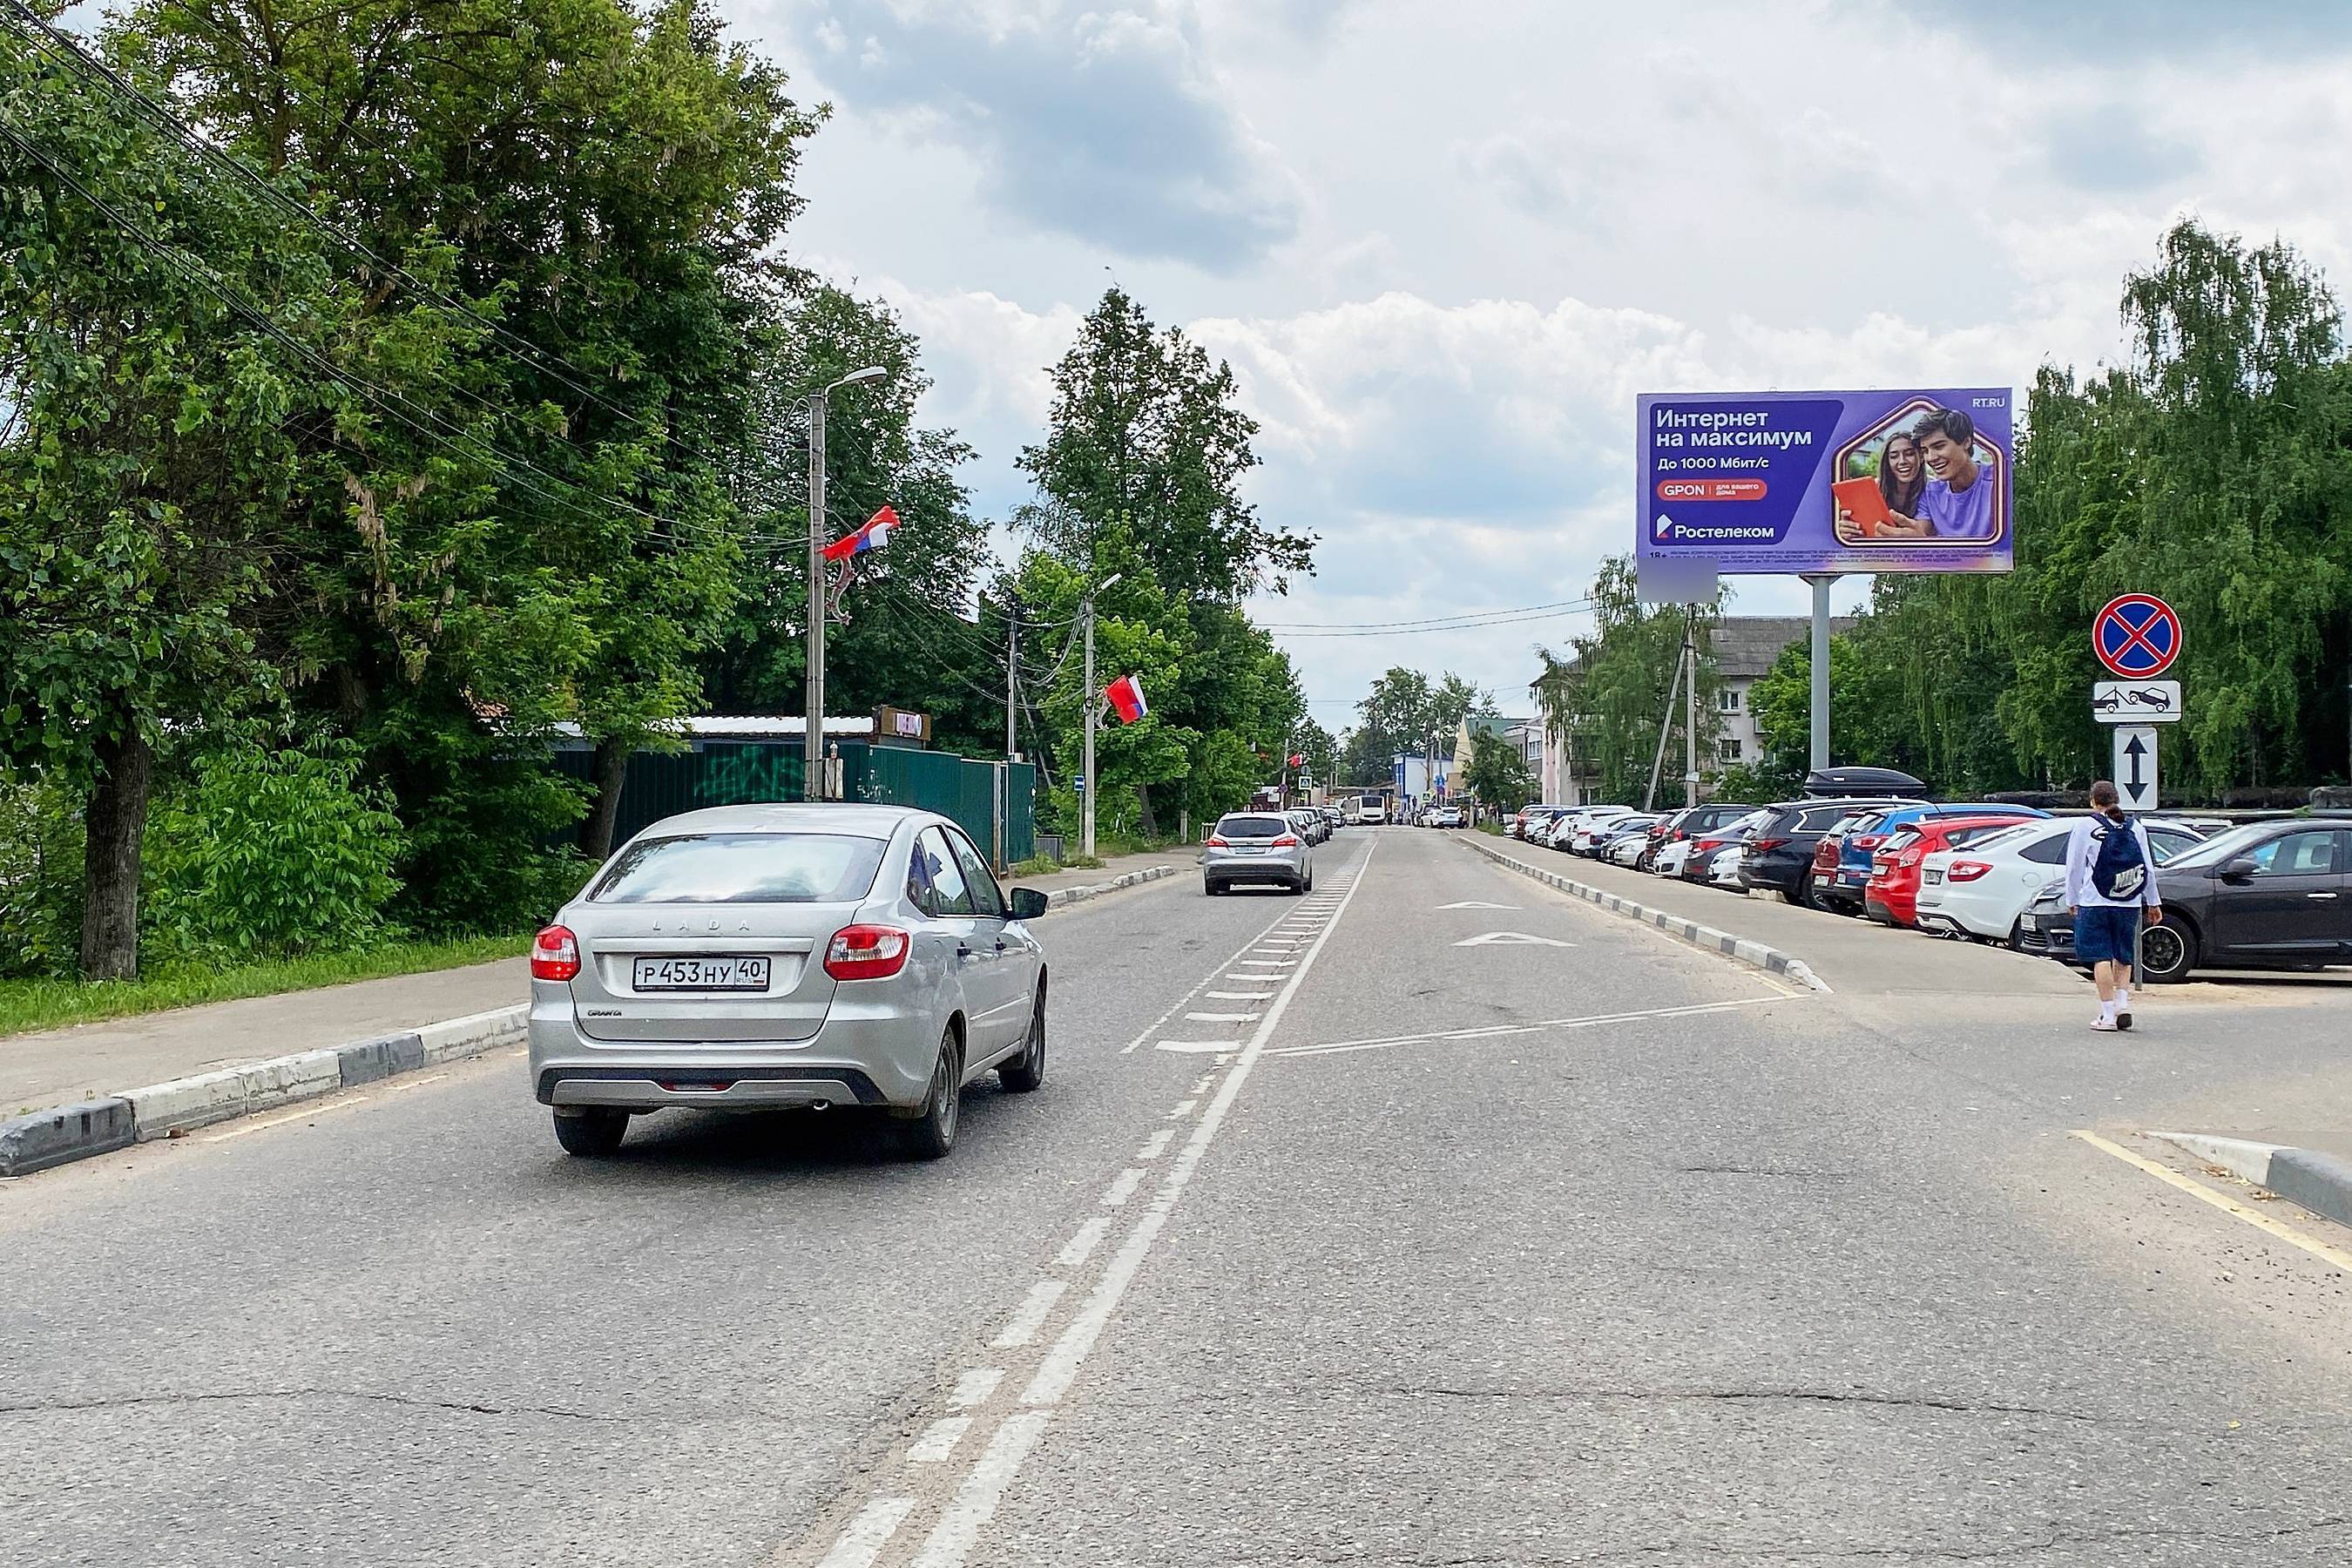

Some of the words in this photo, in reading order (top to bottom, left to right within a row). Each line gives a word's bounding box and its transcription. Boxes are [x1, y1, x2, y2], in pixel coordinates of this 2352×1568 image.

[1972, 396, 2005, 408] RT.RU
[1656, 409, 1768, 431] Интернет
[1656, 432, 1684, 447] на
[1691, 430, 1812, 450] максимум
[1658, 457, 1677, 470] До
[1680, 457, 1716, 469] 1000
[1720, 456, 1769, 469] Мбит/с
[1664, 484, 1705, 496] GPON
[1674, 524, 1774, 538] Ростелеком
[652, 919, 750, 931] LADA
[738, 960, 760, 977] 40
